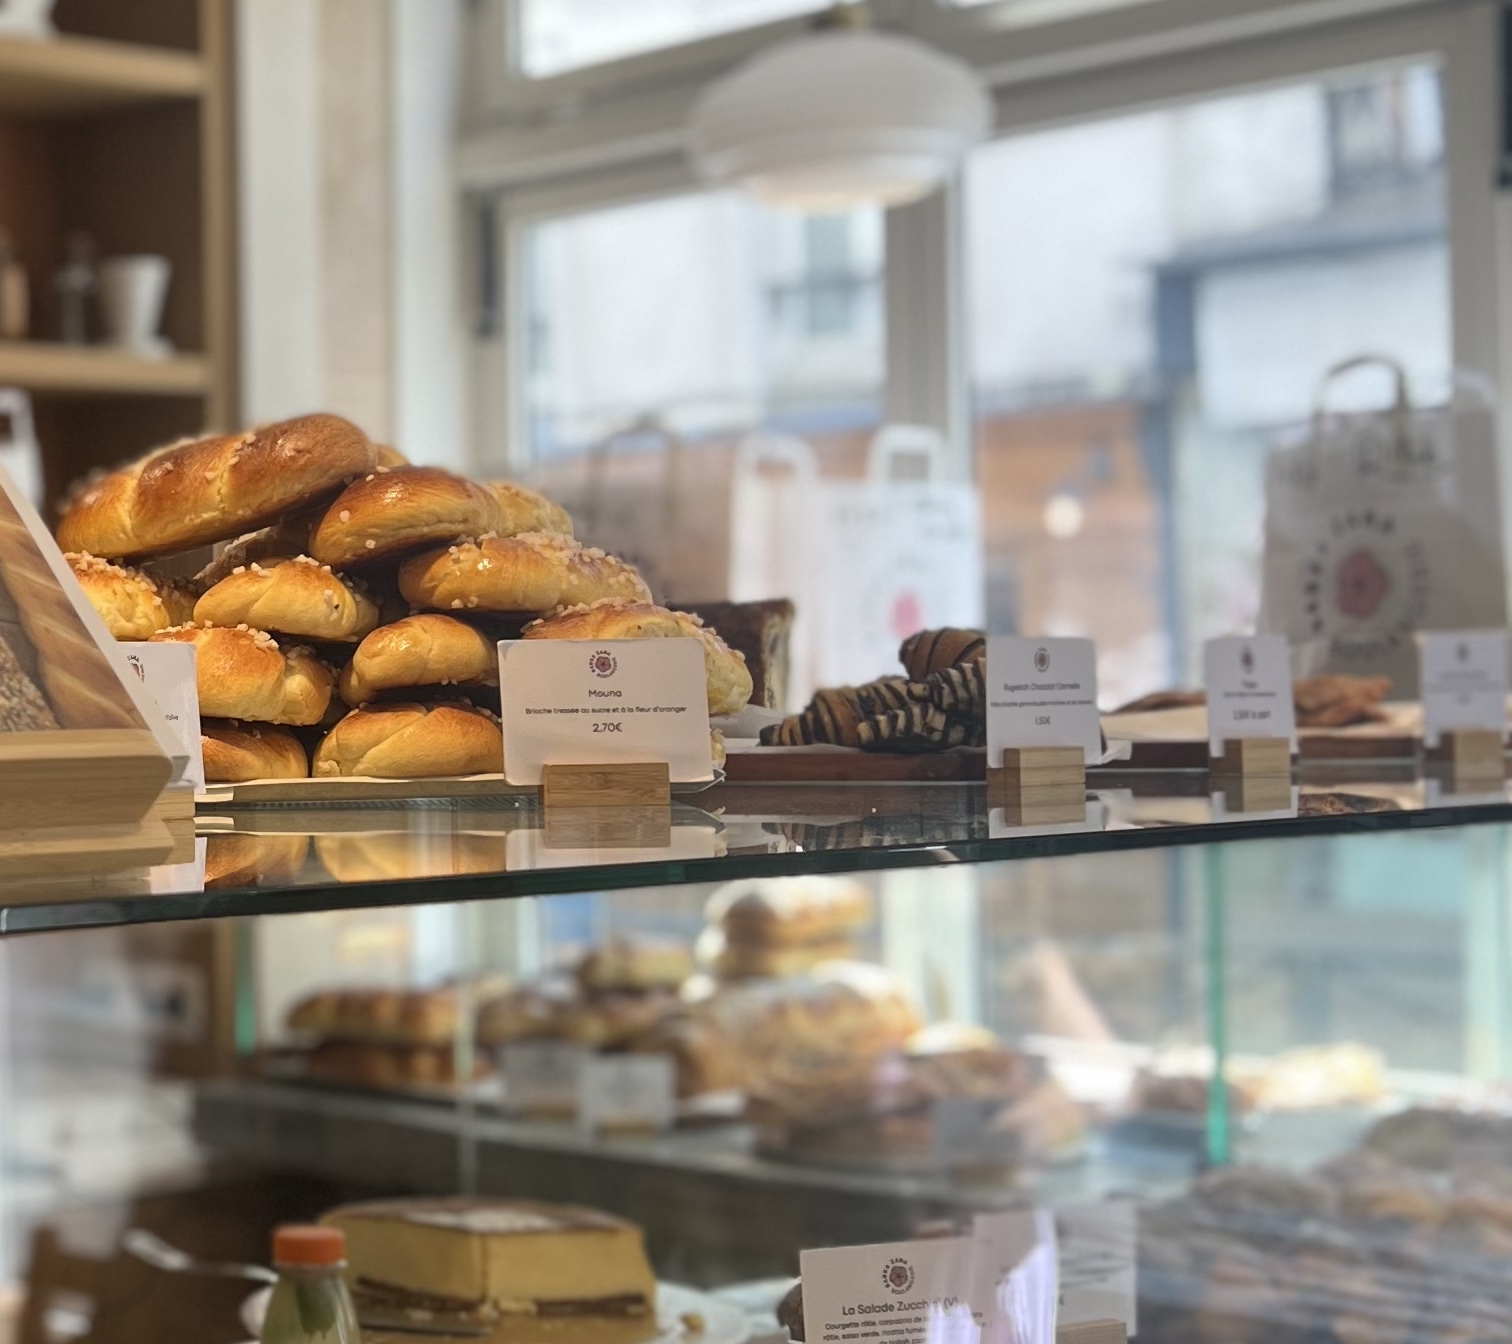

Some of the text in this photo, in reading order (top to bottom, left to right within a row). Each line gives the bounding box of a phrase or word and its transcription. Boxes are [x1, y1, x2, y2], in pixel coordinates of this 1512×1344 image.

[588, 689, 623, 698] Mouna
[620, 706, 626, 714] à
[652, 706, 687, 714] d'oranger
[592, 722, 623, 733] 2,70€
[842, 1306, 856, 1316] La
[857, 1302, 895, 1315] Salade
[825, 1322, 859, 1330] Courgette
